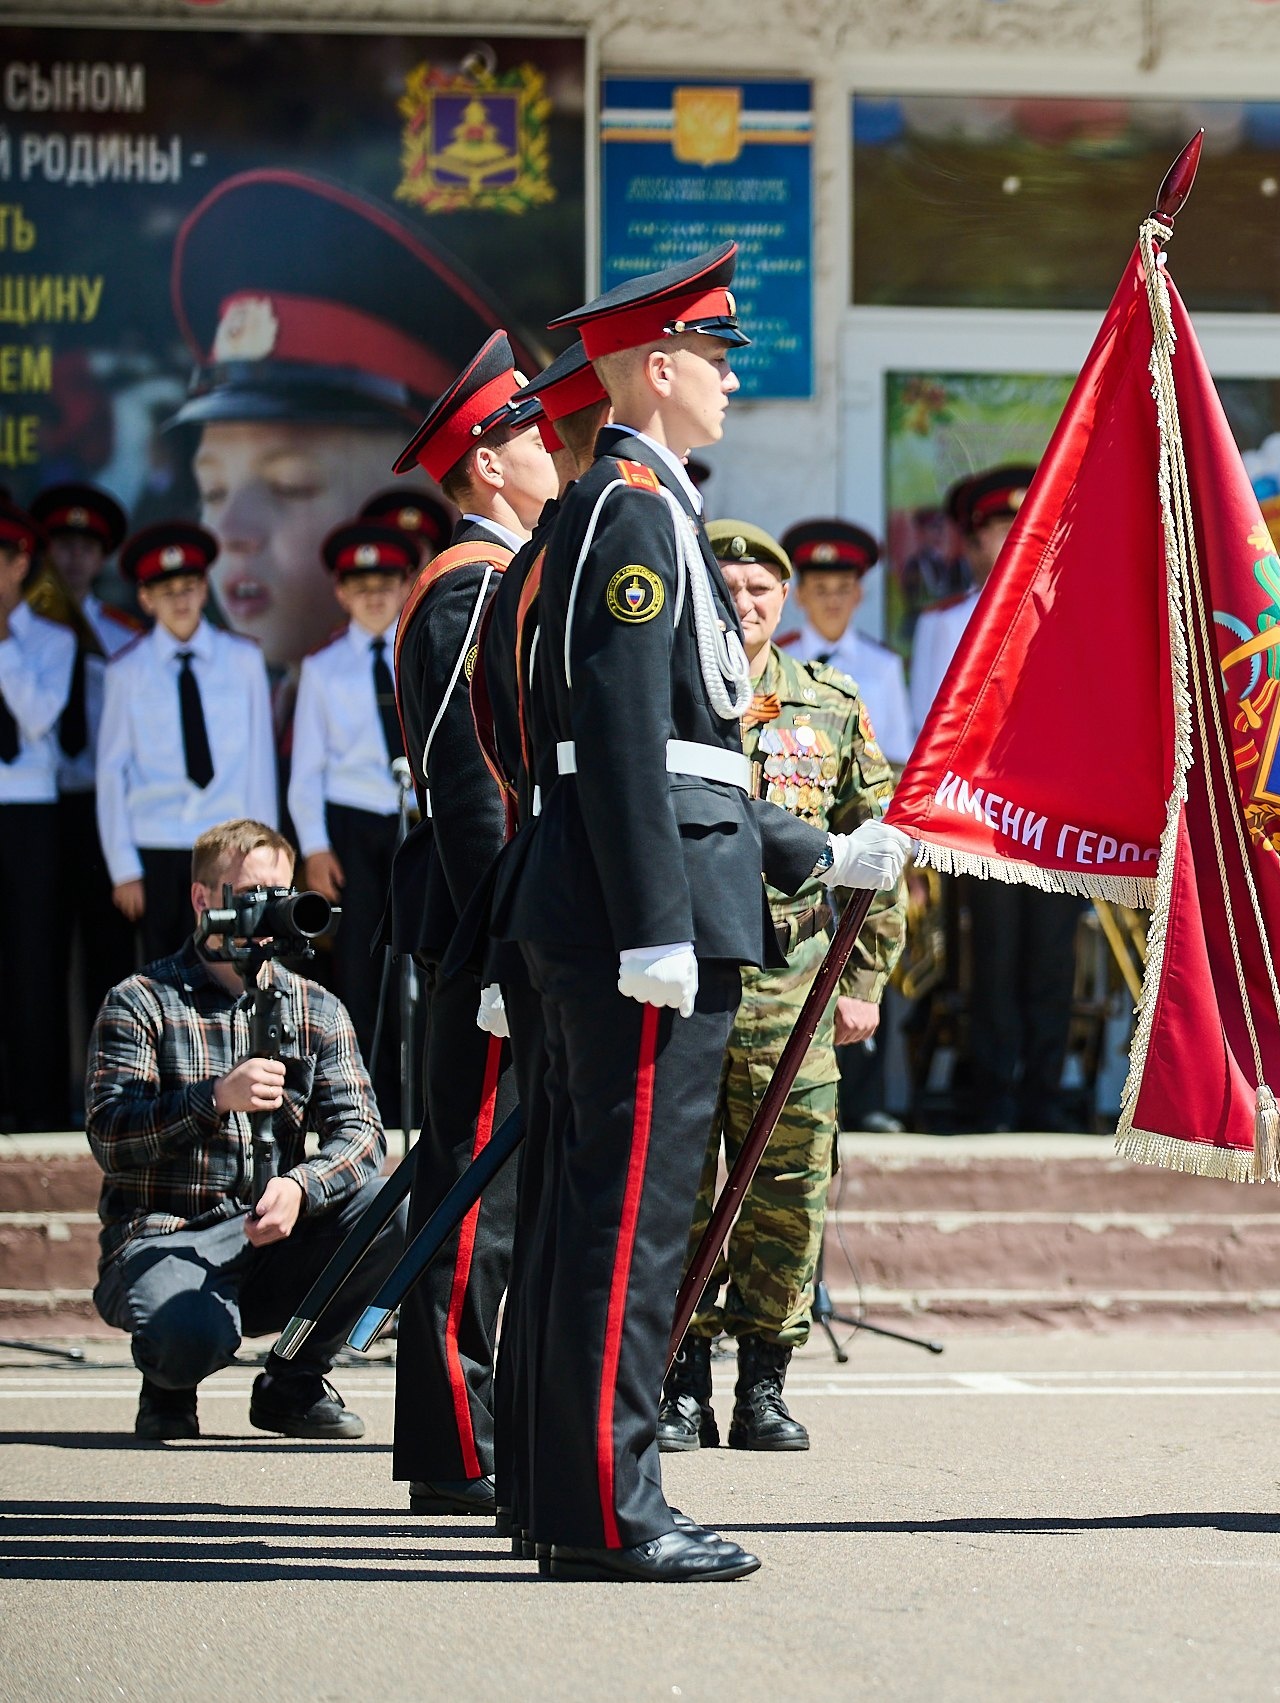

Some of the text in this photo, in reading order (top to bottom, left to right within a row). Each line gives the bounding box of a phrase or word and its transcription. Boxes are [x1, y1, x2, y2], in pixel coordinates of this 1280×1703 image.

[5, 62, 146, 111] СЫНОМ
[21, 135, 182, 186] РОДИНЫ
[935, 770, 1048, 851] ИМЕНИ
